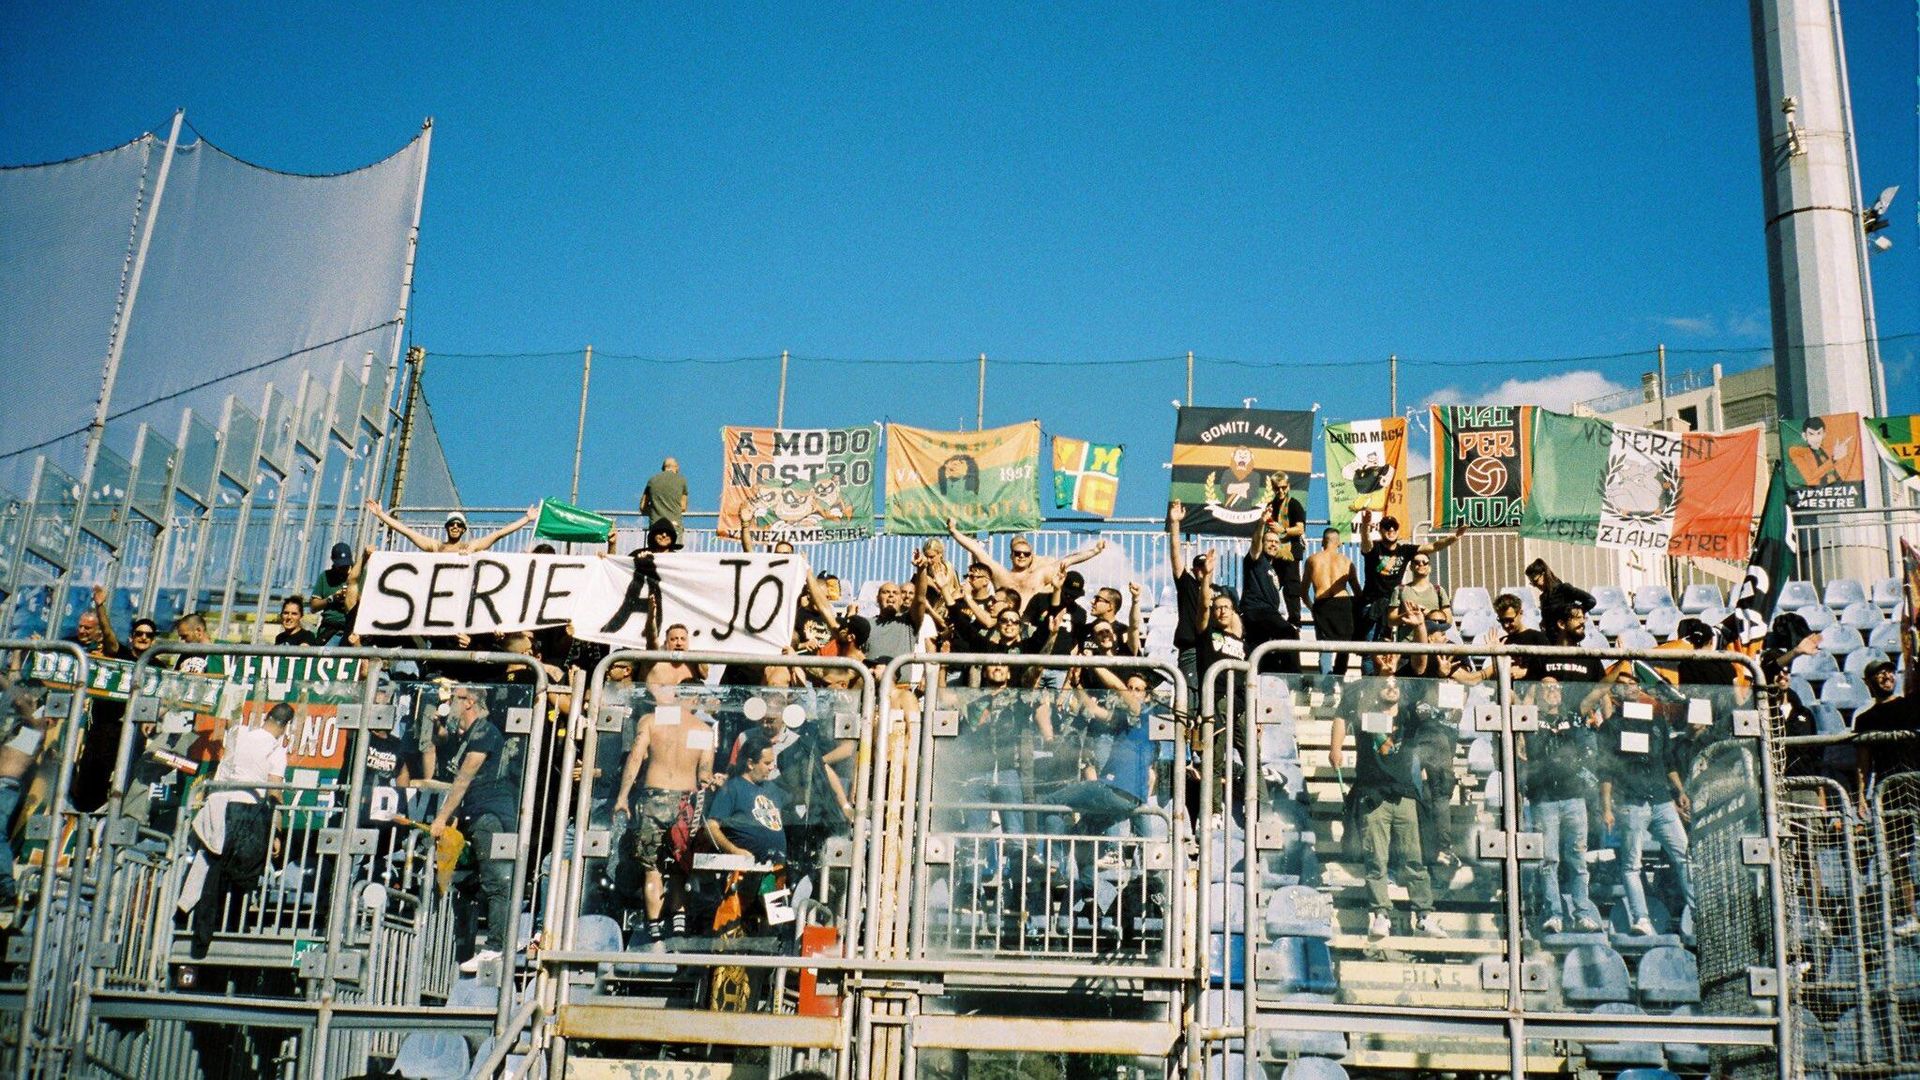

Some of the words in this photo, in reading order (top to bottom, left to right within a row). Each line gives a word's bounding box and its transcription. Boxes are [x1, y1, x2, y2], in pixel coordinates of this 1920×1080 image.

[1457, 405, 1514, 428] MAI
[734, 431, 757, 456] A
[772, 429, 871, 456] MODO
[1201, 421, 1250, 443] GOMITI
[1254, 424, 1289, 448] ALTI
[1458, 430, 1515, 460] PER
[1584, 422, 1714, 460] VETERANI
[731, 459, 871, 488] NOSTRO
[1797, 486, 1858, 499] VENEZIA
[1797, 498, 1855, 508] MESTRE
[1451, 496, 1524, 527] MODA
[728, 526, 868, 543] VNEZIAMESTRE
[1545, 518, 1727, 550] VENEZIAMESTRE
[372, 558, 585, 631] SERIE
[600, 556, 662, 639] A
